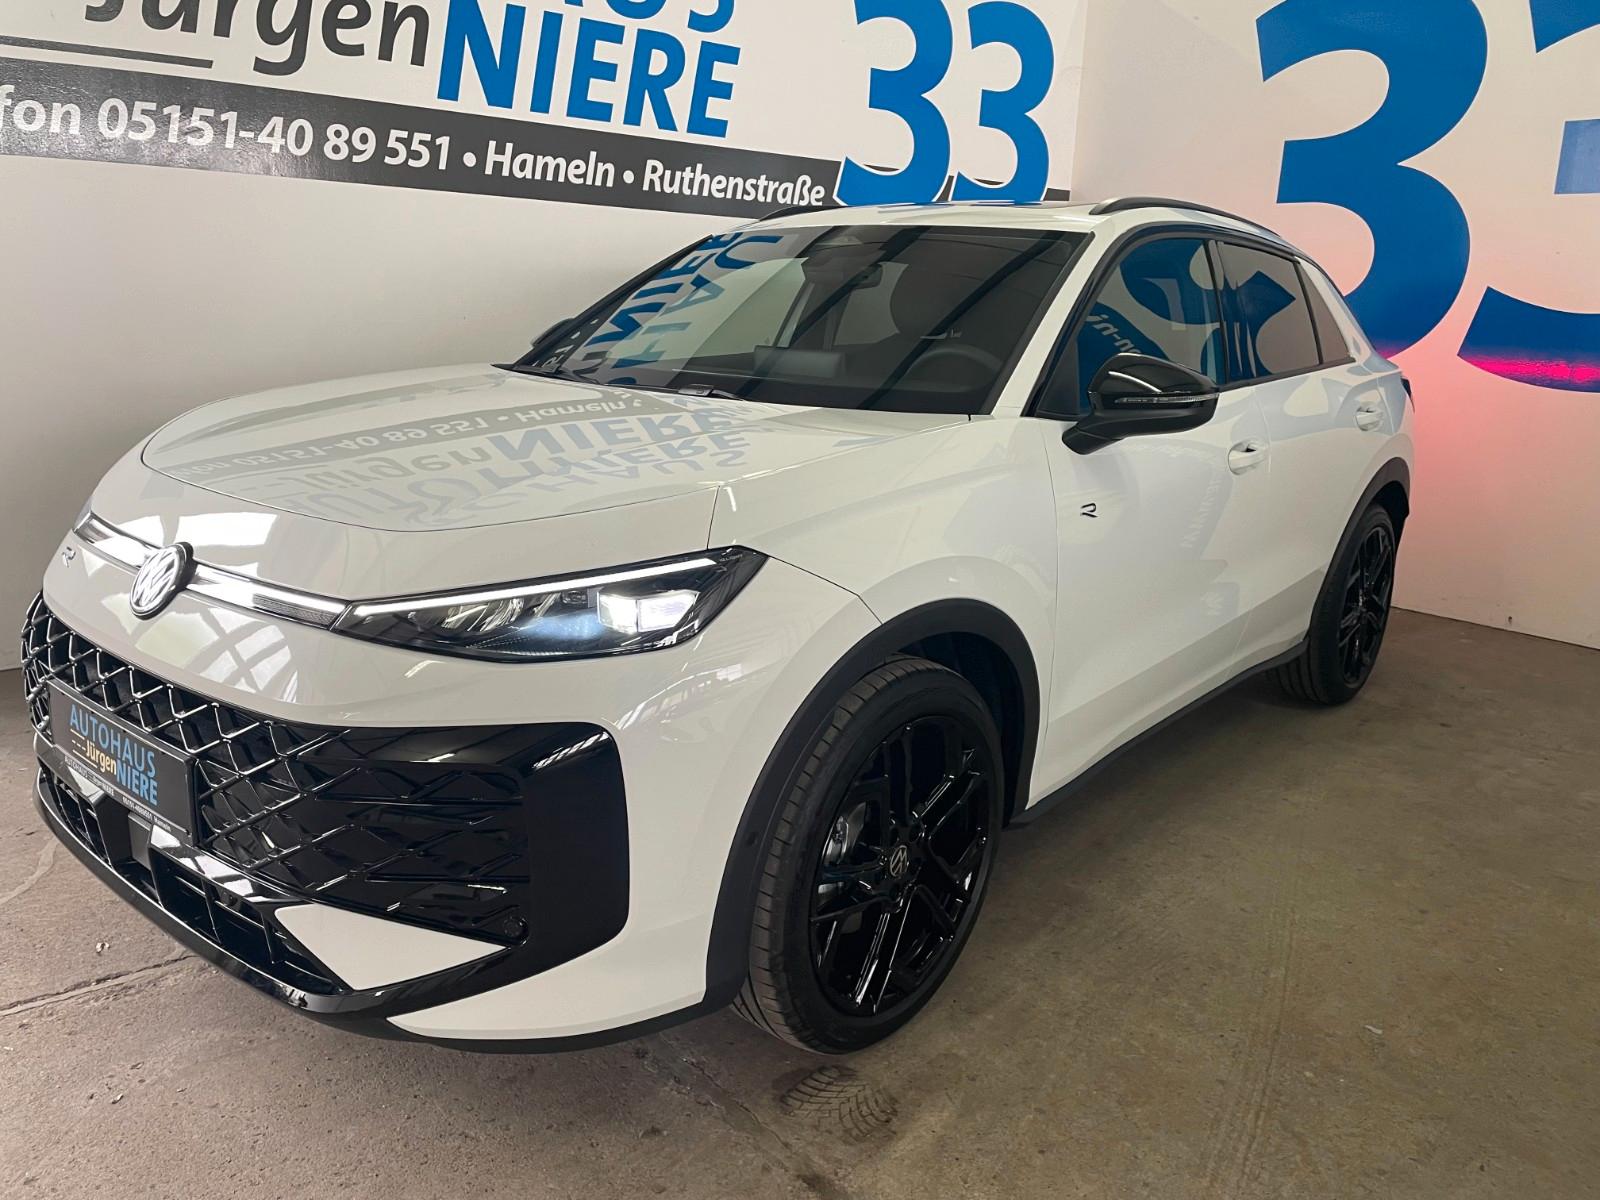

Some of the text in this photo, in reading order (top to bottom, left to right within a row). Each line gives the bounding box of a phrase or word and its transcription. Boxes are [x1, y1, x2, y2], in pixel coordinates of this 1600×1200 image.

[85, 0, 741, 138] rgen NIERE
[97, 97, 313, 157] 05151-40
[323, 123, 377, 163] 89
[384, 130, 450, 170] 551
[485, 140, 615, 188] Hameln
[642, 159, 825, 207] Ruthenstraße
[69, 704, 157, 778] AUTOHAUS
[85, 740, 117, 776] Jürgen
[116, 758, 158, 806] NIERE
